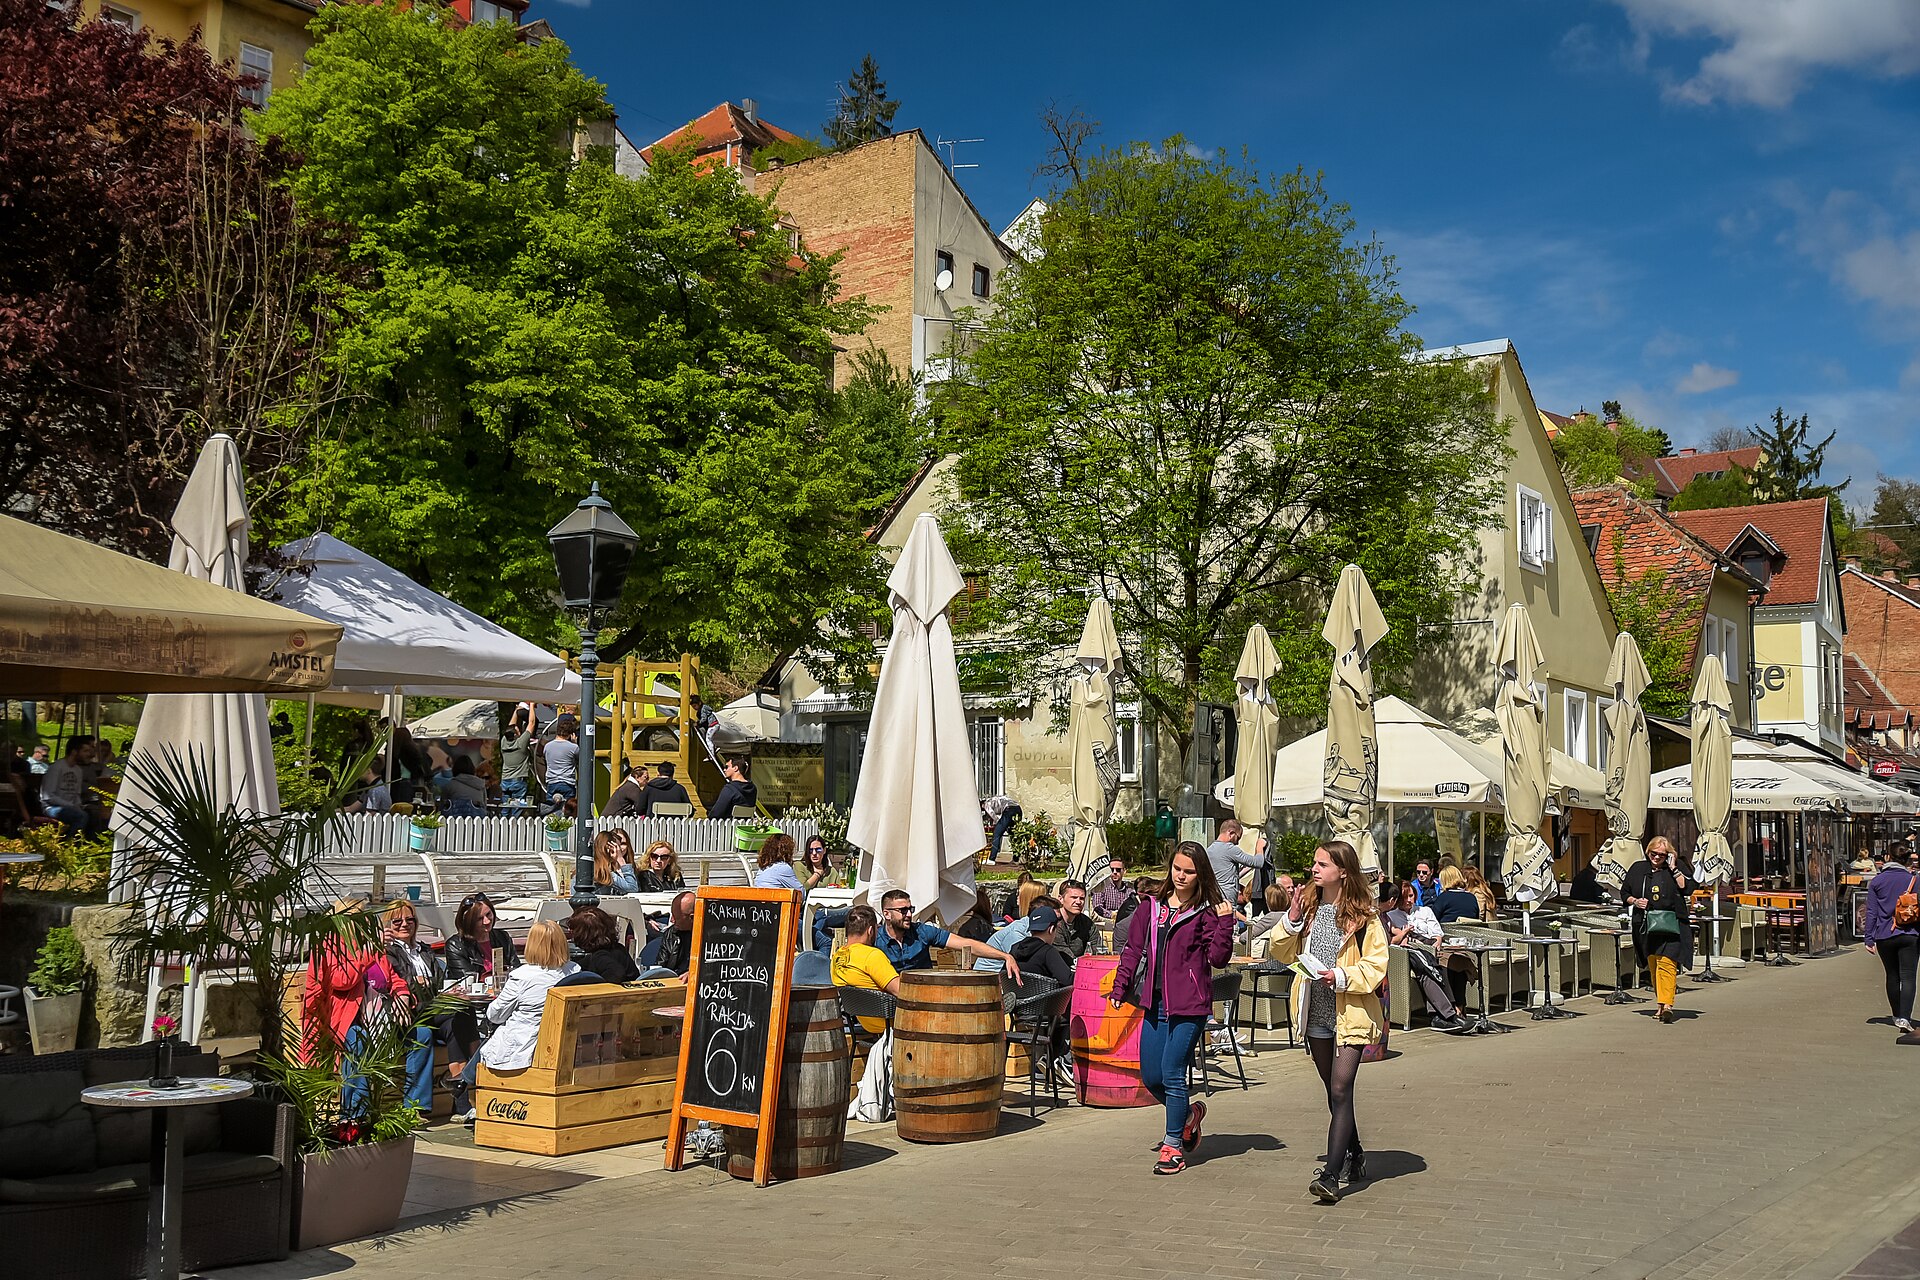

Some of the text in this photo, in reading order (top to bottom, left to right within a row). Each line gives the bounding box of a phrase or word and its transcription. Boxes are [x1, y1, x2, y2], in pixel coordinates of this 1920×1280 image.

[268, 651, 326, 673] AMSTEL
[709, 902, 772, 924] RAKHIA BAR
[705, 942, 744, 961] HAPPY
[720, 964, 769, 982] HOUR(S)
[704, 1027, 737, 1096] 6
[486, 1097, 530, 1121] Coca-Cola
